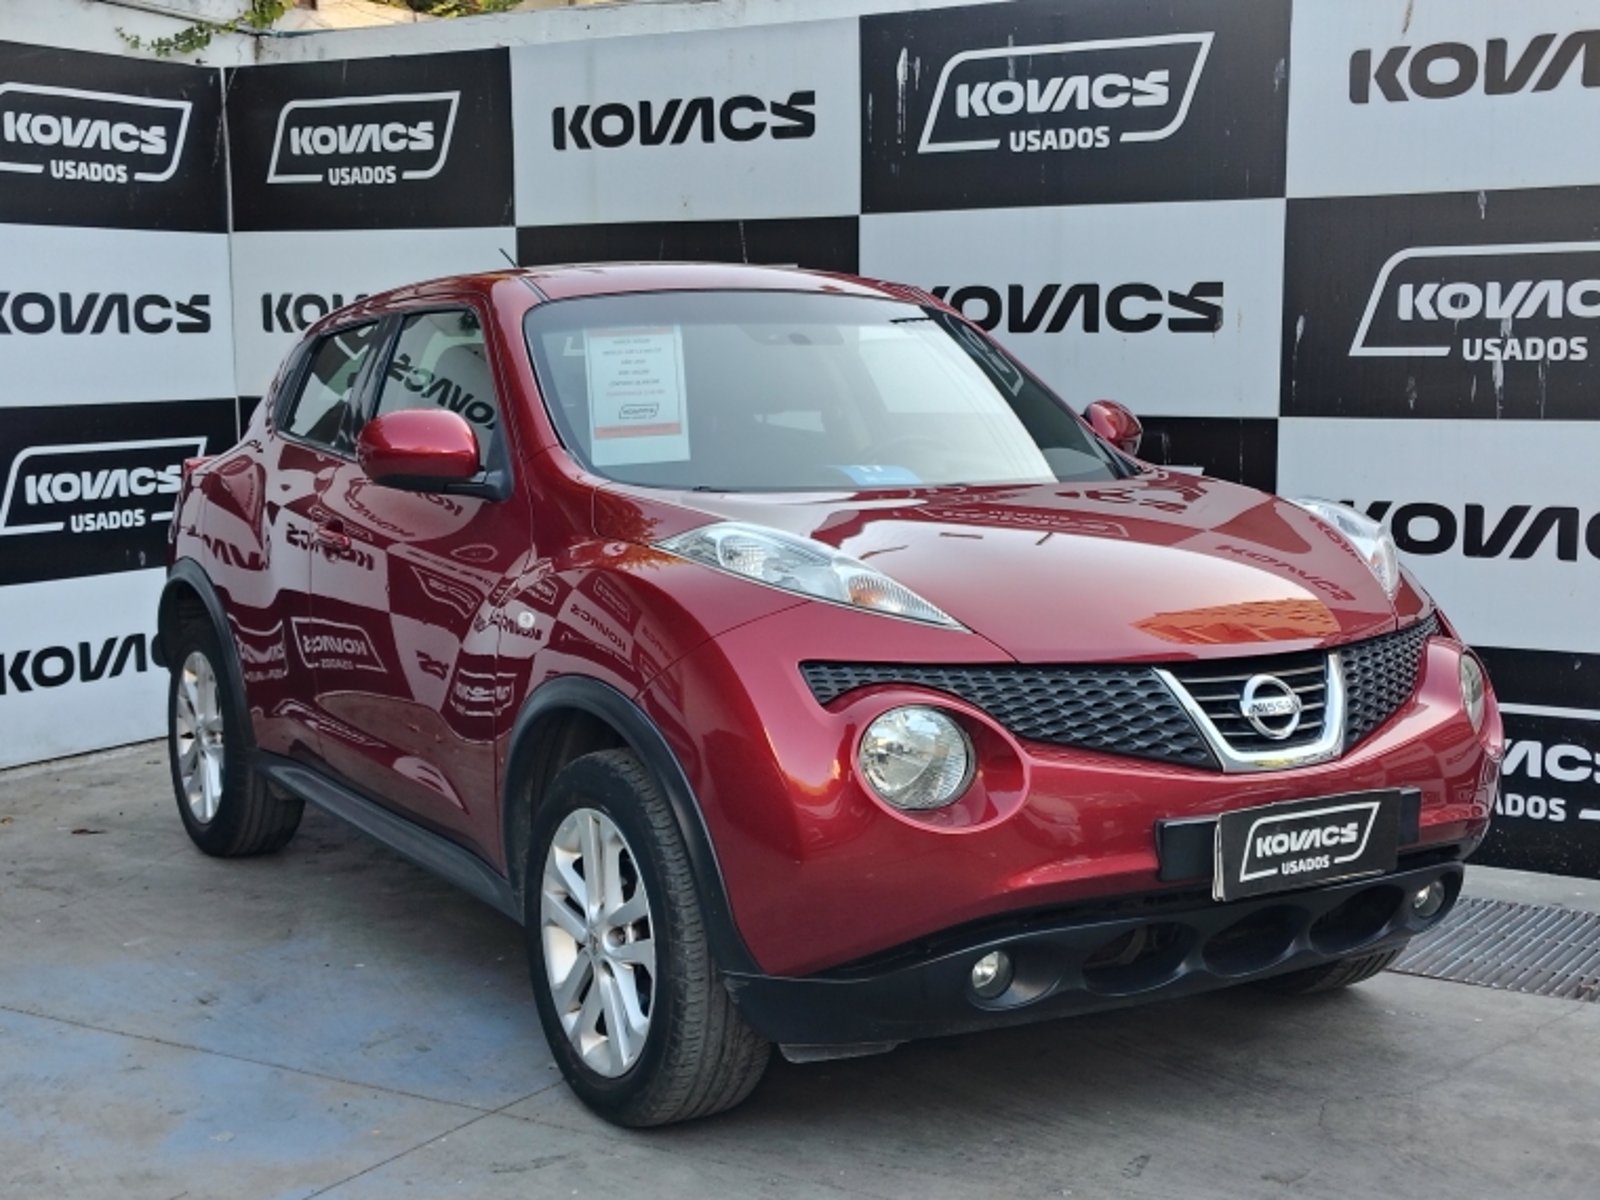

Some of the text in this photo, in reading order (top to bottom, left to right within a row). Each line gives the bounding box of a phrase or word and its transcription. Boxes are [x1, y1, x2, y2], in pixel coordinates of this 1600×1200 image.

[956, 70, 1169, 118] KOVACS
[4, 111, 167, 154] KOVACS
[290, 121, 434, 156] KOVACS
[552, 90, 816, 151] KOVACS
[1009, 126, 1110, 152] USADOS
[50, 160, 128, 183] USADOS
[329, 165, 397, 186] USADOS
[931, 282, 1223, 333] OVACS
[1462, 336, 1588, 361] USADOS
[25, 464, 182, 505] KOVACS
[71, 509, 146, 533] USADOS
[1338, 500, 1600, 562] OVA
[0, 632, 168, 695] KOVA
[1256, 822, 1359, 858] KOVACS
[1281, 854, 1330, 875] USADOS
